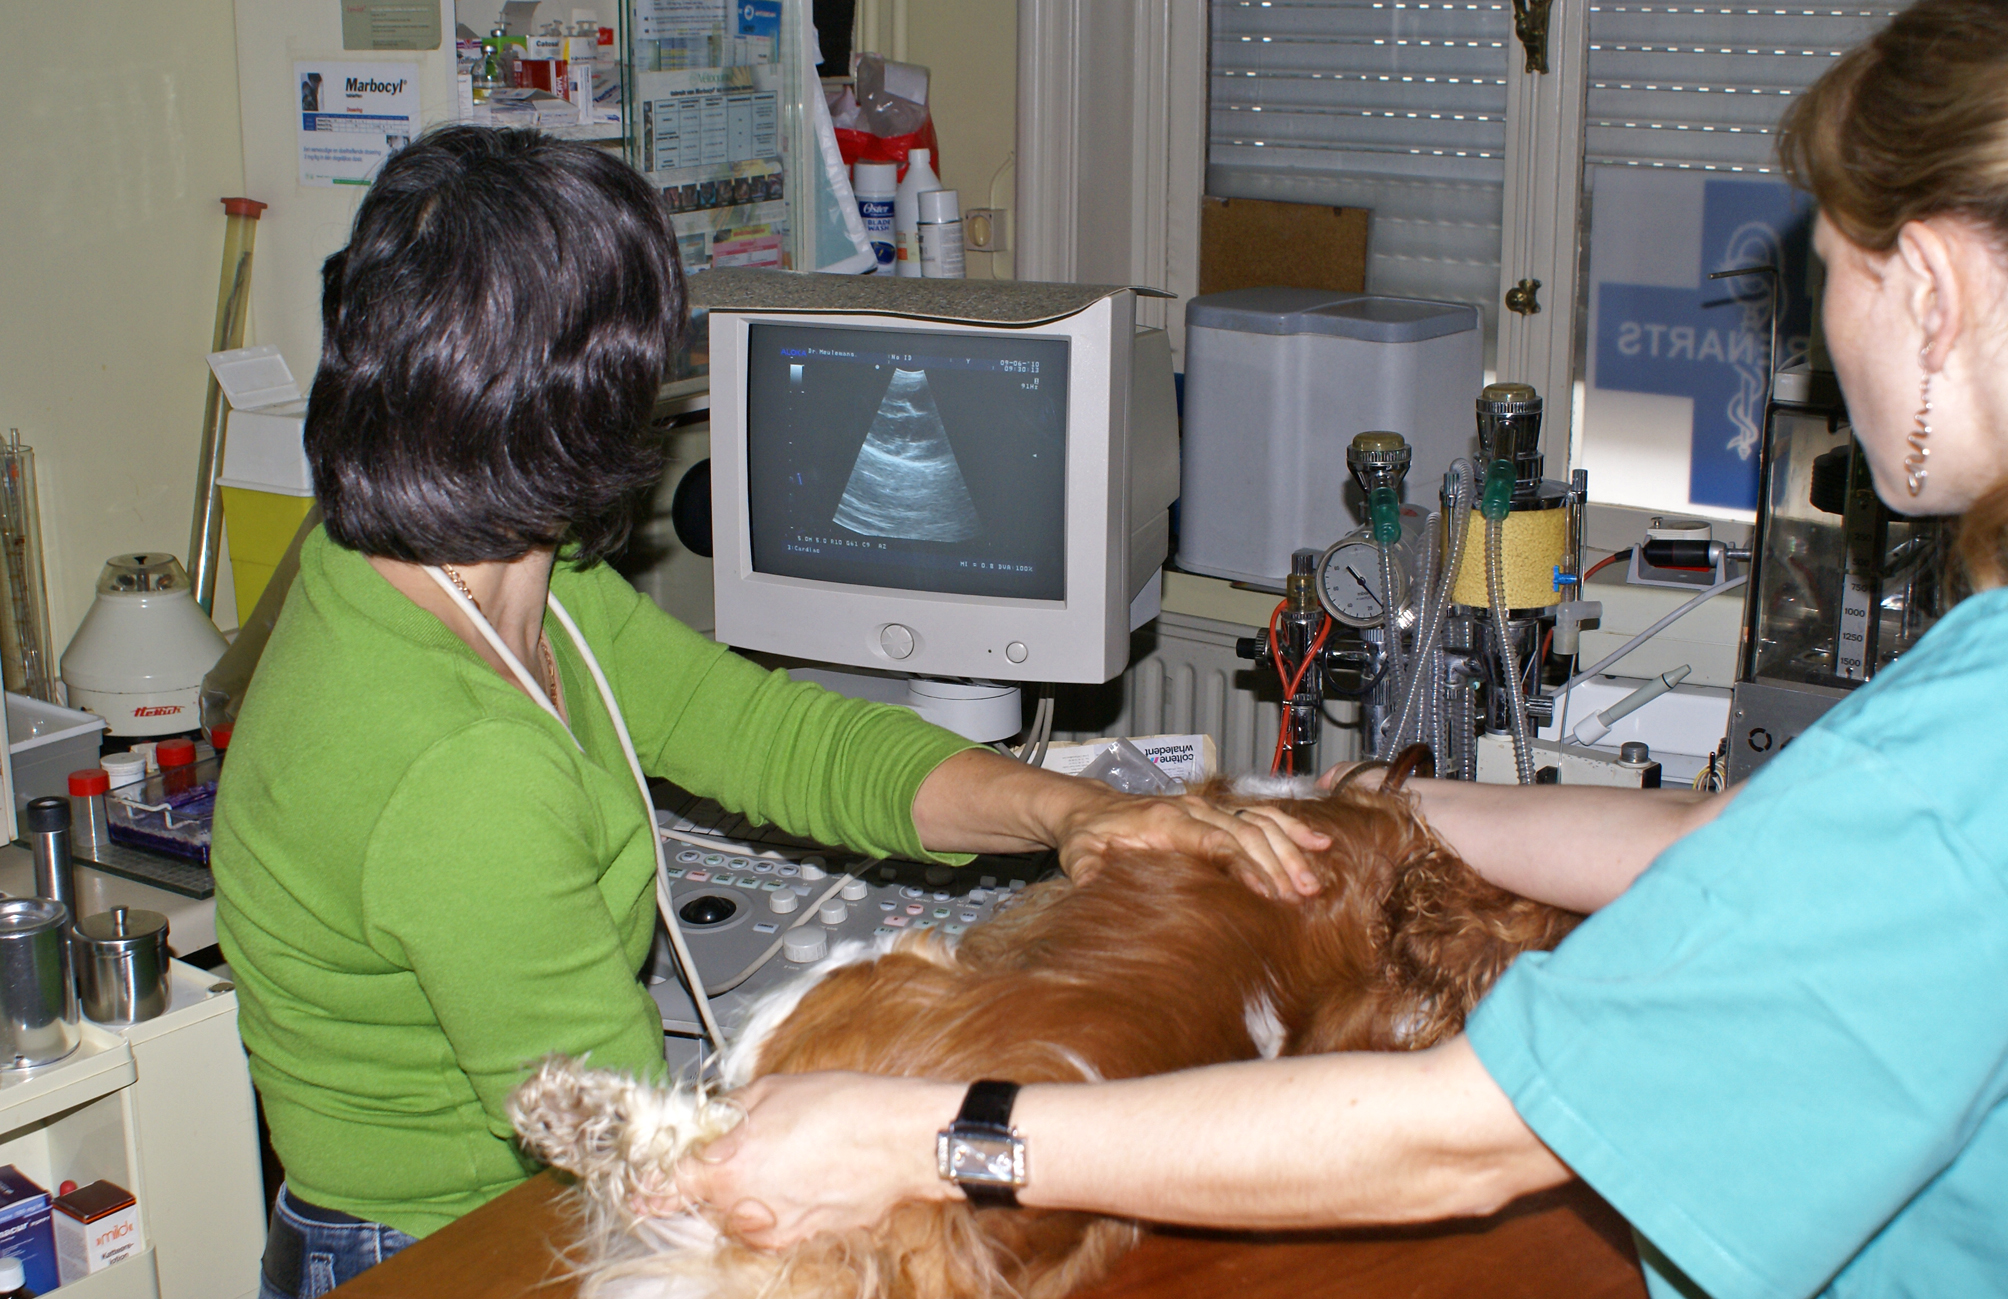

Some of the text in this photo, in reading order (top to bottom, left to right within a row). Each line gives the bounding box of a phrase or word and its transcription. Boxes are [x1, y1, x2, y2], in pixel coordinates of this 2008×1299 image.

[863, 202, 889, 214] Oster
[1851, 582, 1867, 592] 750
[1844, 607, 1866, 617] 1000
[1842, 632, 1863, 642] 1250
[1840, 657, 1861, 667] 1500
[1145, 745, 1194, 757] whaledent
[1160, 754, 1194, 764] coltène
